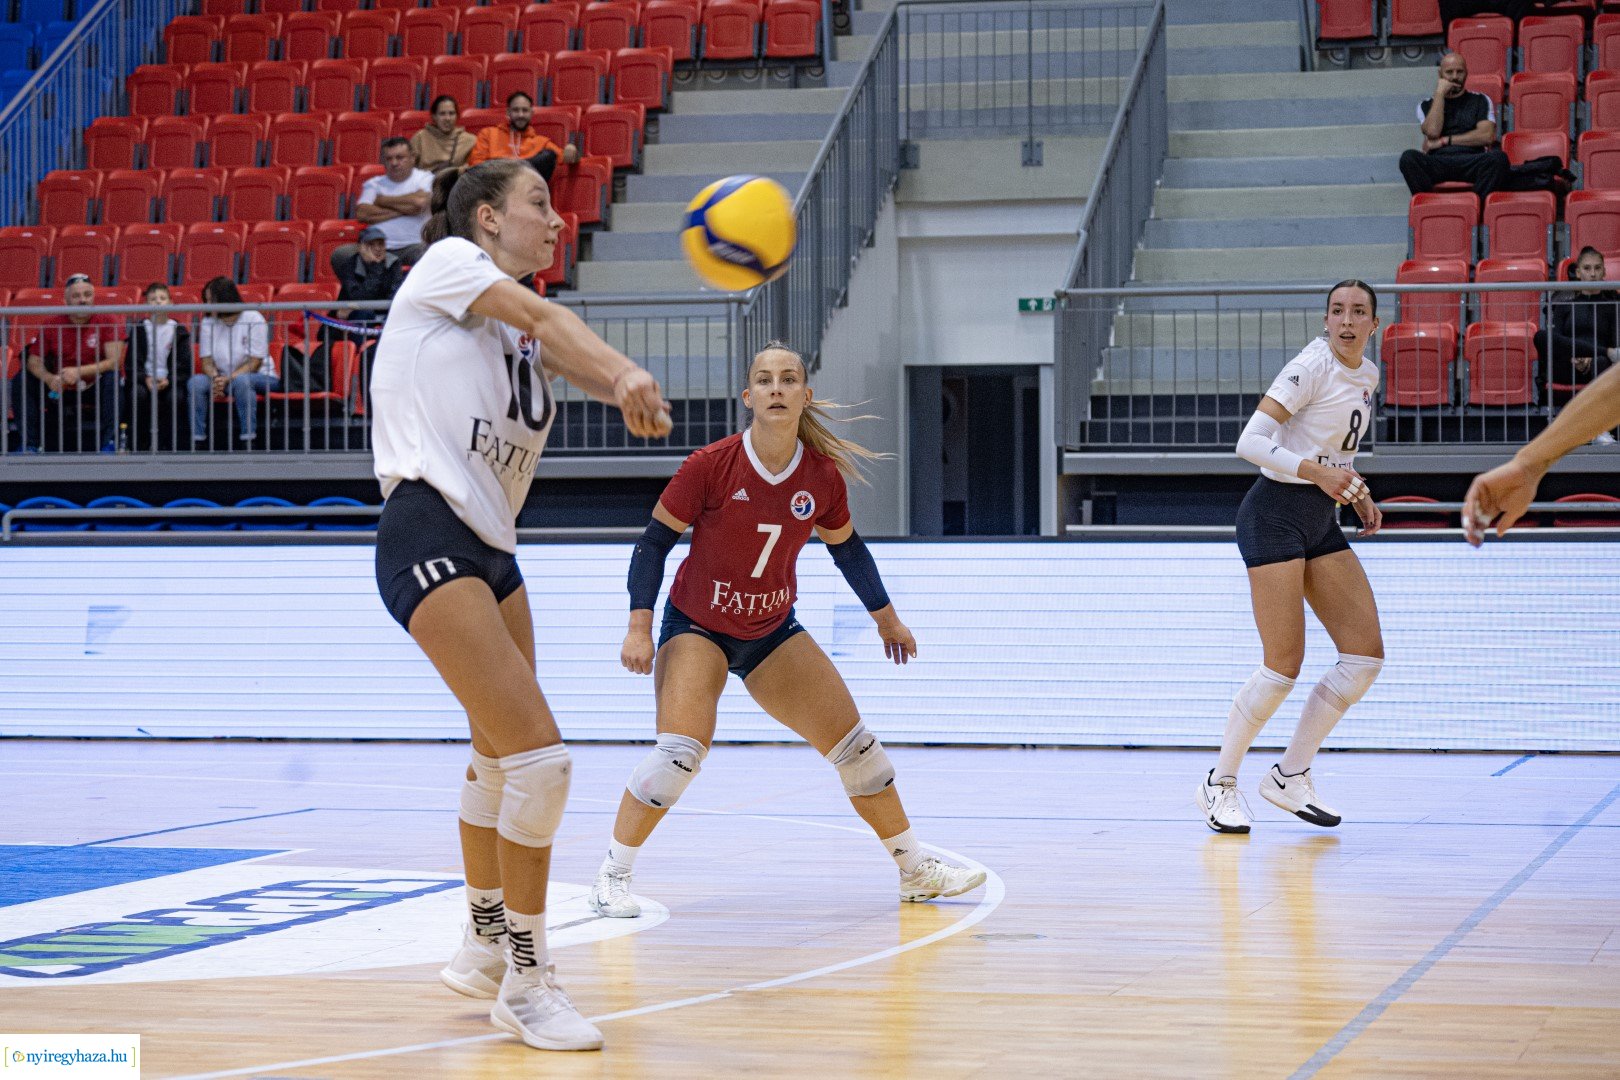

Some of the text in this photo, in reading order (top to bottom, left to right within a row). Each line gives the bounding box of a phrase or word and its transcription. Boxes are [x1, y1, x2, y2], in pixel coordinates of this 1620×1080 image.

[504, 354, 552, 432] 10
[1341, 409, 1362, 451] 8
[750, 523, 782, 578] 7
[710, 579, 790, 610] FATUM
